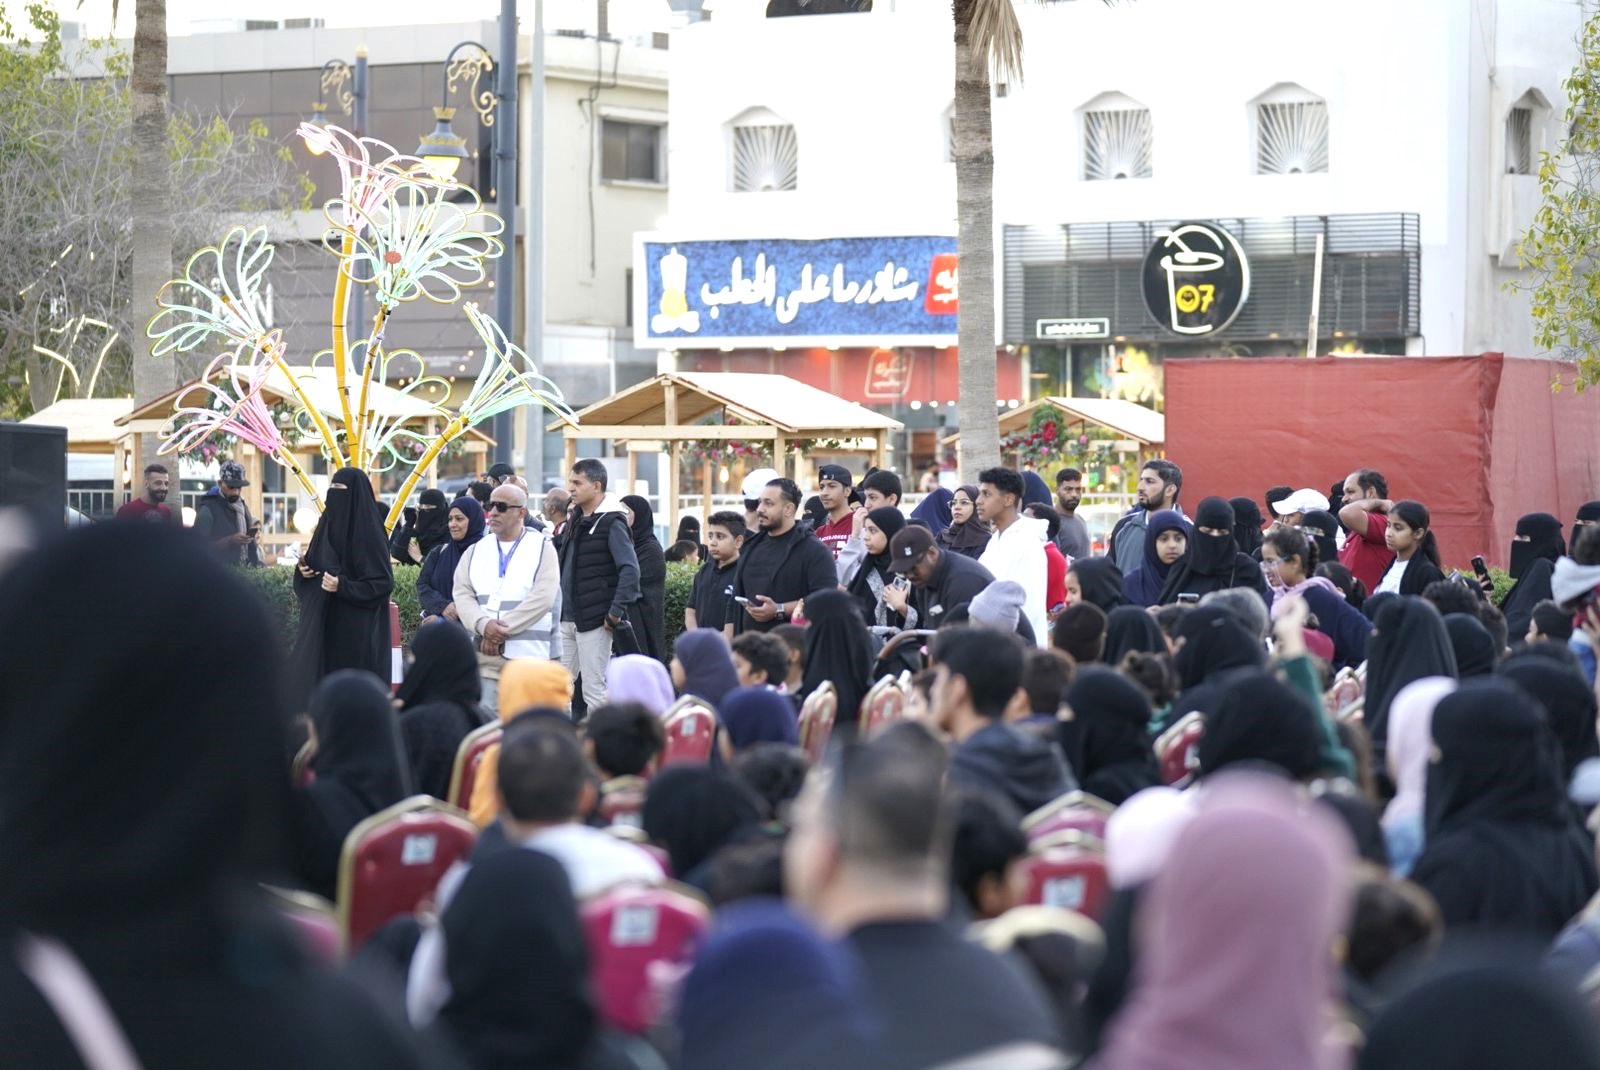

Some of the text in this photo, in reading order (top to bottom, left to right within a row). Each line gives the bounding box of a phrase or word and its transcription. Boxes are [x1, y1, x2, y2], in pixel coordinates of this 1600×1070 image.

[701, 253, 776, 319] الحطب
[776, 263, 831, 324] على
[833, 262, 919, 304] شاورما
